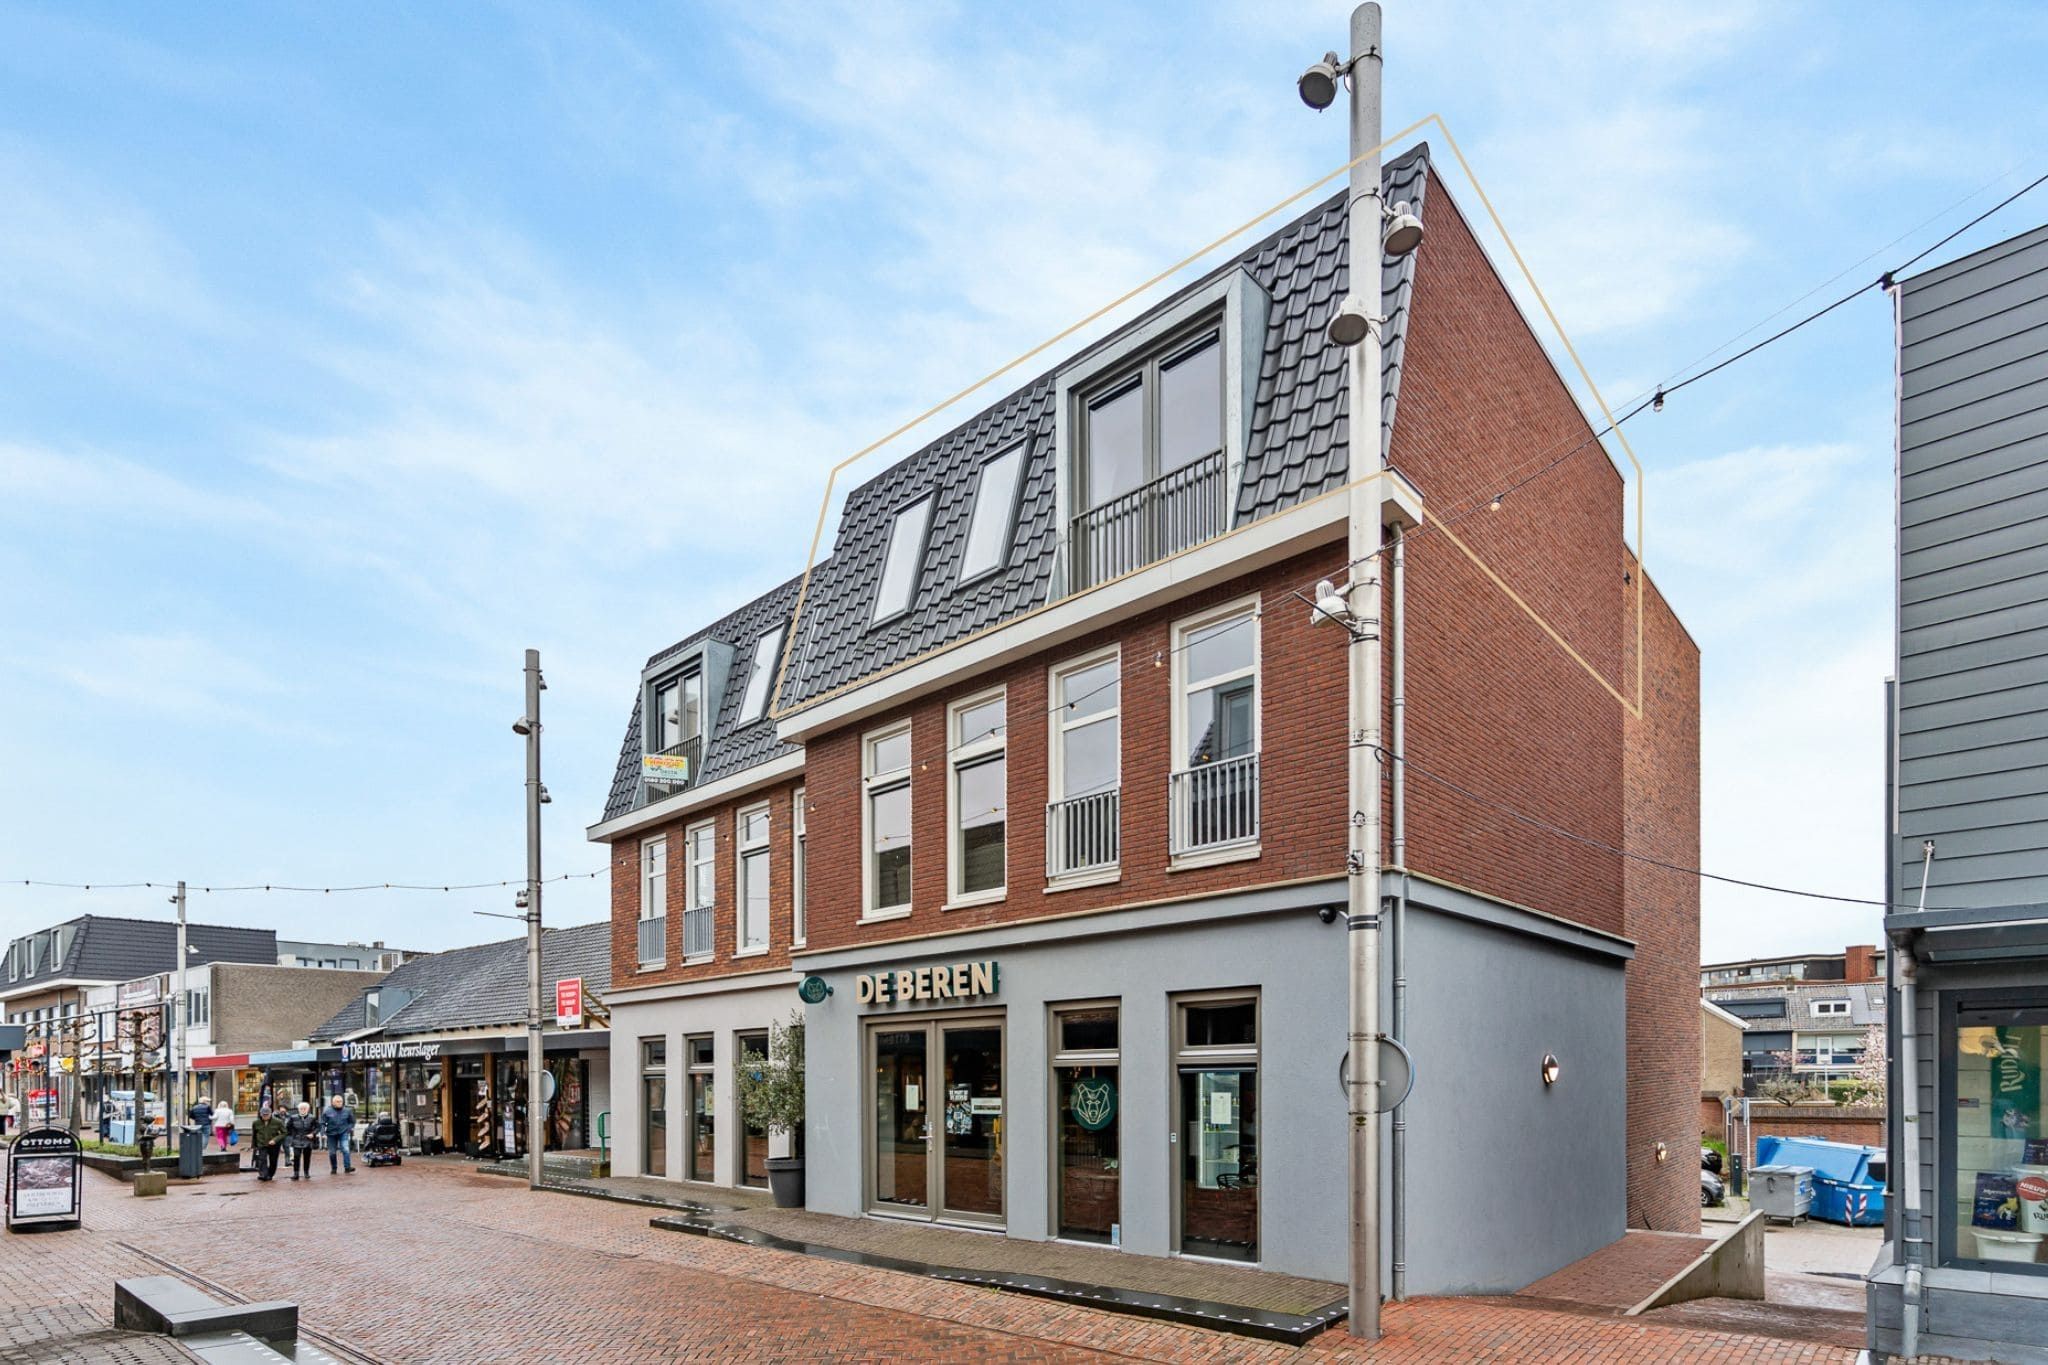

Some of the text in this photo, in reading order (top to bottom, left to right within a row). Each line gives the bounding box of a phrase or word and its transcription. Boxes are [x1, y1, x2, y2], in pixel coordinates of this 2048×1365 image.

[856, 960, 994, 1004] DE BEREN
[350, 1042, 362, 1060] De
[21, 1138, 71, 1146] OTTOMO
[2020, 1182, 2047, 1194] NIEUW
